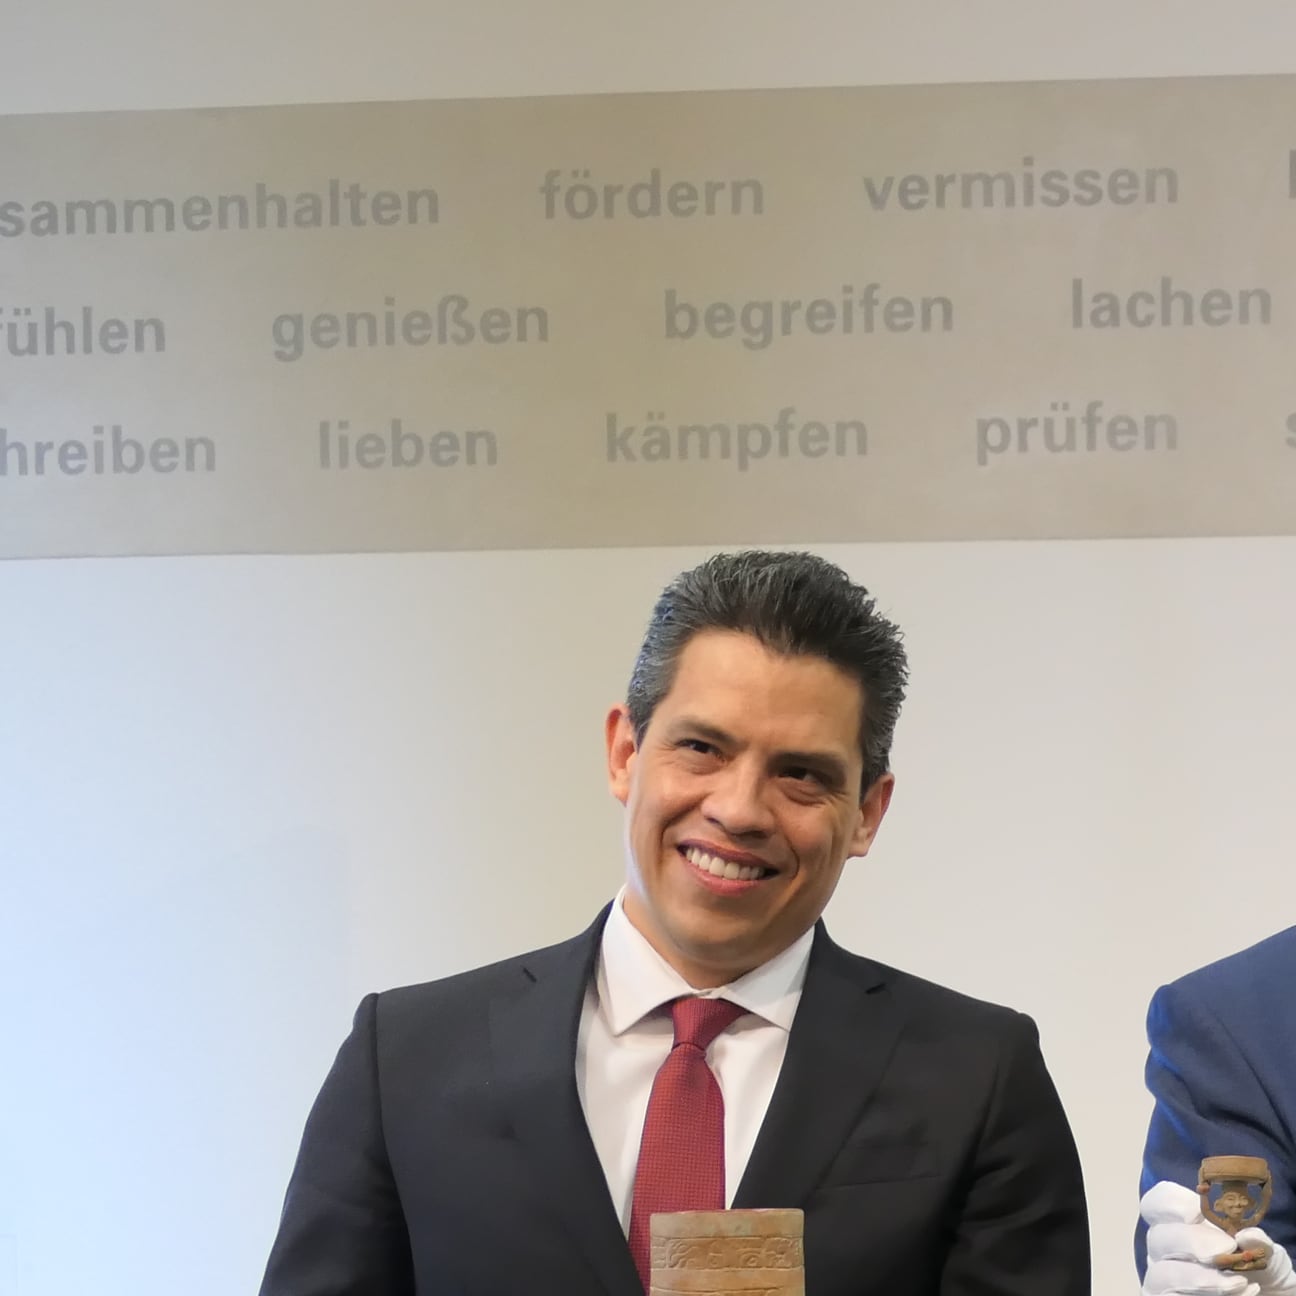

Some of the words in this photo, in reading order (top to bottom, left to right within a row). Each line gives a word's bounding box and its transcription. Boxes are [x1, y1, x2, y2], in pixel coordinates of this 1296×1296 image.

[0, 179, 439, 238] sammenhalten
[539, 168, 764, 220] fördern
[863, 156, 1178, 211] vermissen
[0, 306, 166, 357] ühlen
[272, 294, 548, 363] genießen
[665, 283, 954, 351] begreifen
[1072, 276, 1272, 329] lachen
[319, 418, 498, 469] lieben
[606, 407, 868, 472] kämpfen
[977, 400, 1178, 466] prüfen
